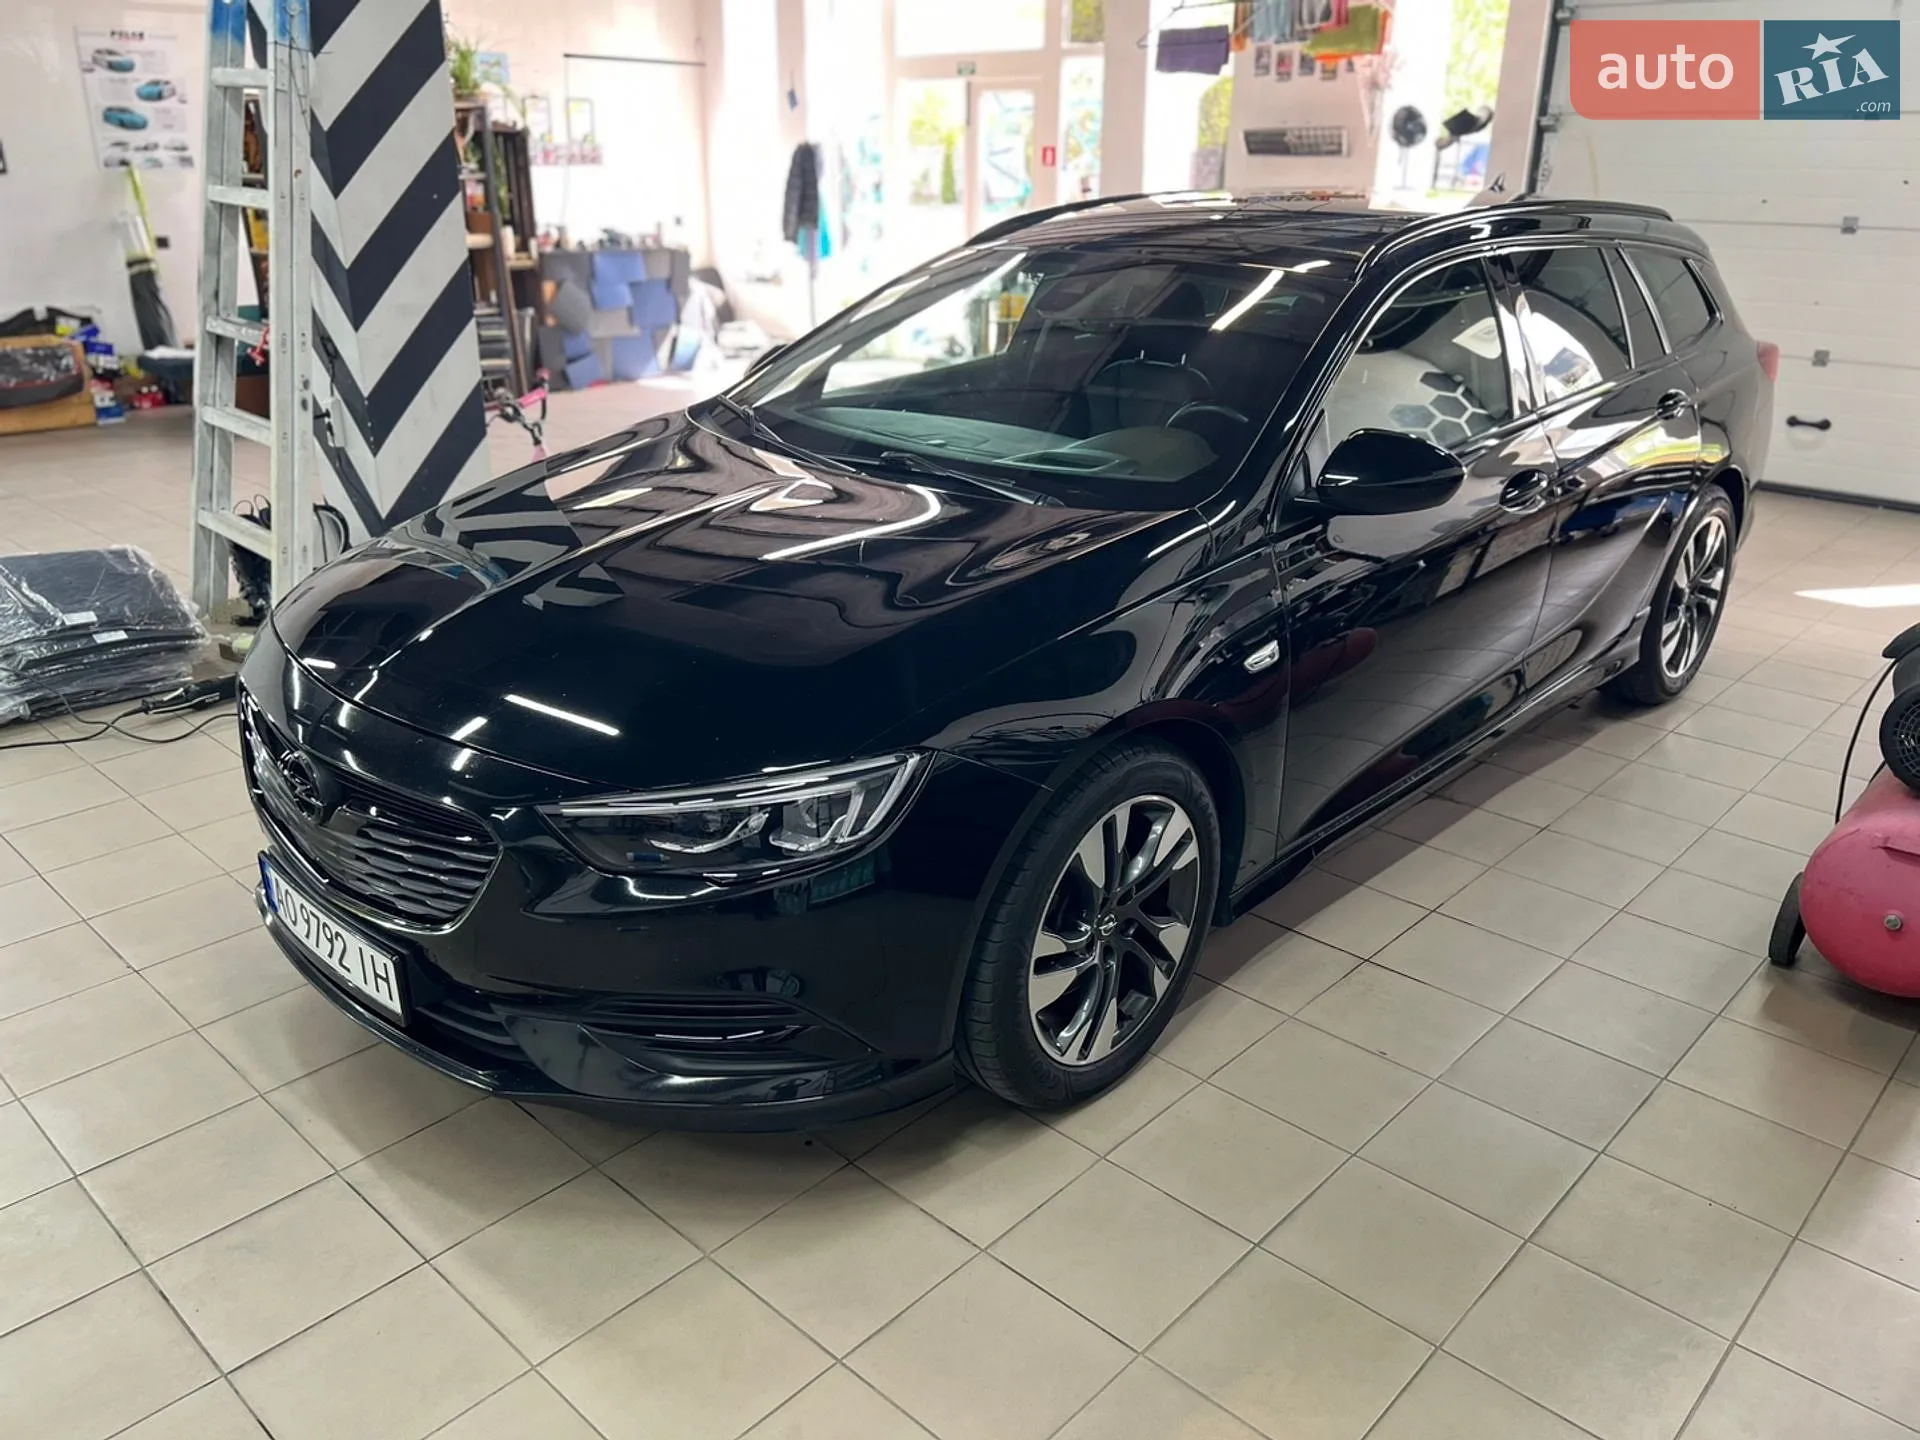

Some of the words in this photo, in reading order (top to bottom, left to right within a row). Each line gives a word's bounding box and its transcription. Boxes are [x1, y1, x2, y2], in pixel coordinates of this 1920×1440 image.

[275, 877, 298, 927] AO
[300, 902, 351, 973] 9792
[359, 946, 394, 1001] IH
